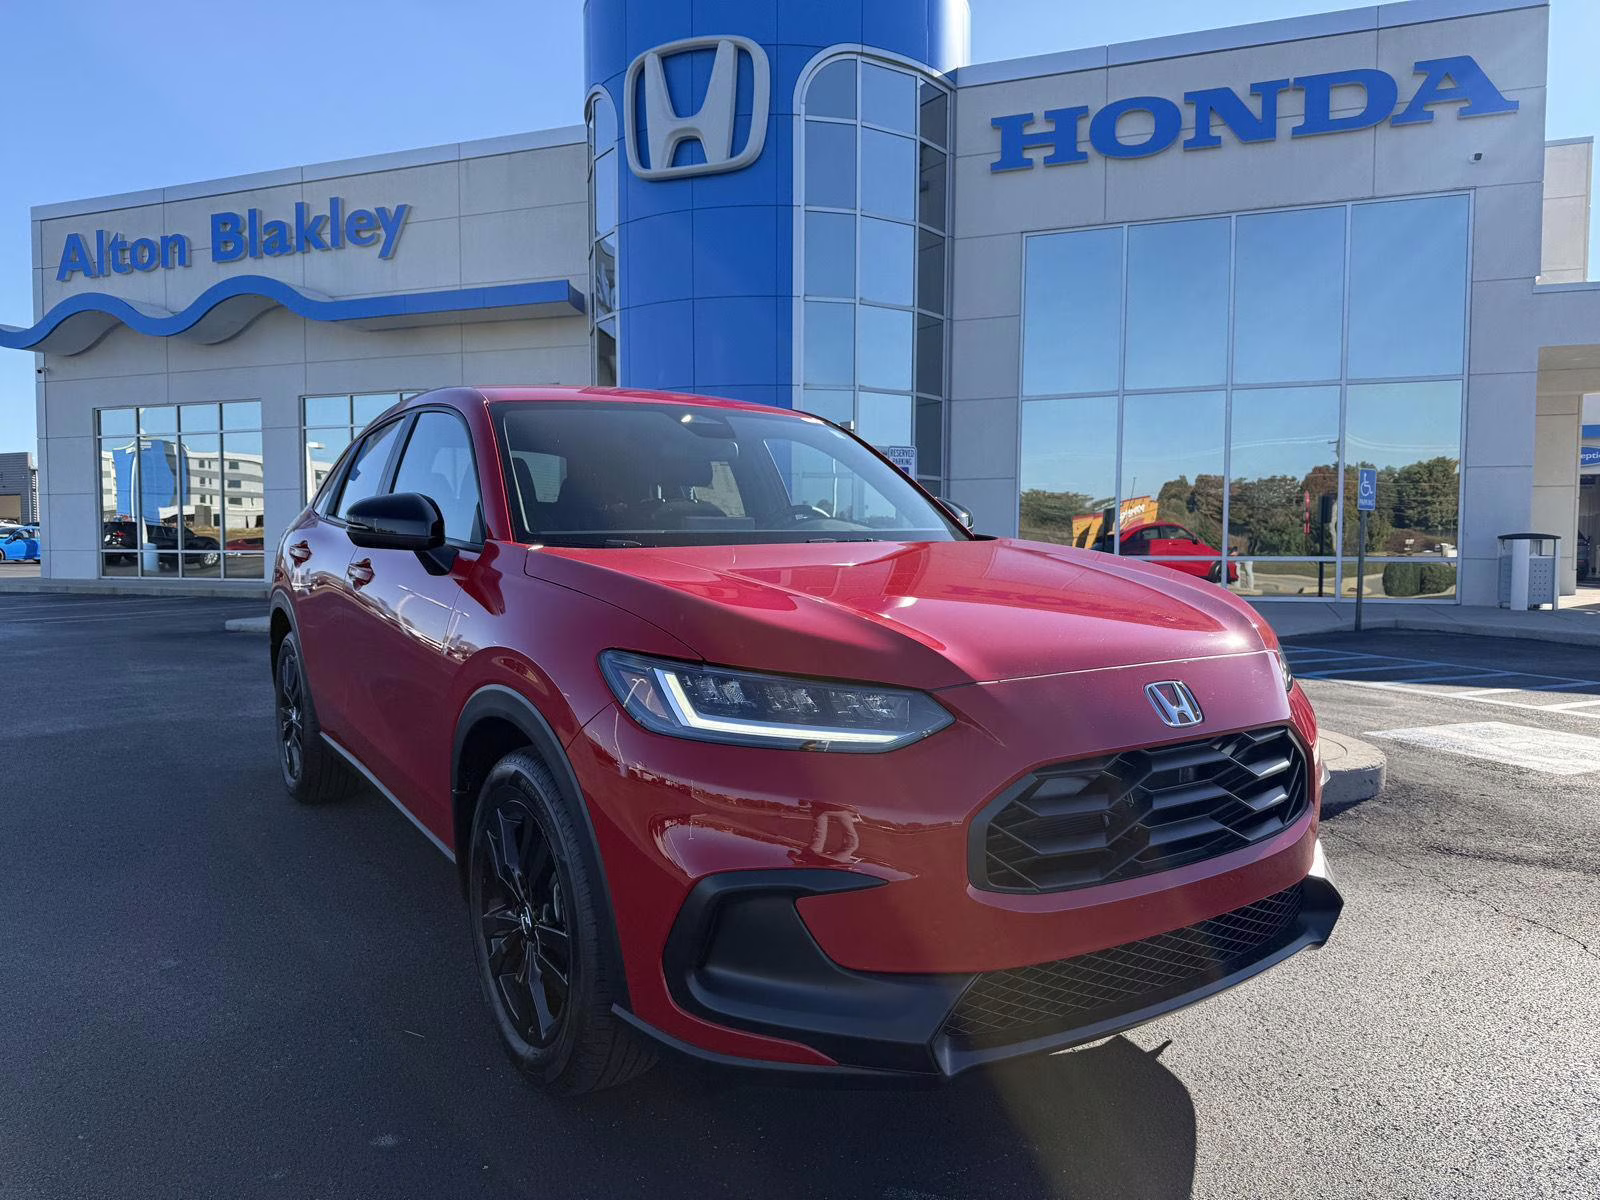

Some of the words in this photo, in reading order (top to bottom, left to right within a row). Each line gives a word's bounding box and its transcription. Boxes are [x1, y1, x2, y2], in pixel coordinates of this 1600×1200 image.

[990, 55, 1519, 173] HONDA
[56, 229, 192, 282] Alton
[210, 196, 412, 263] Blakley
[889, 449, 915, 458] RESERVED
